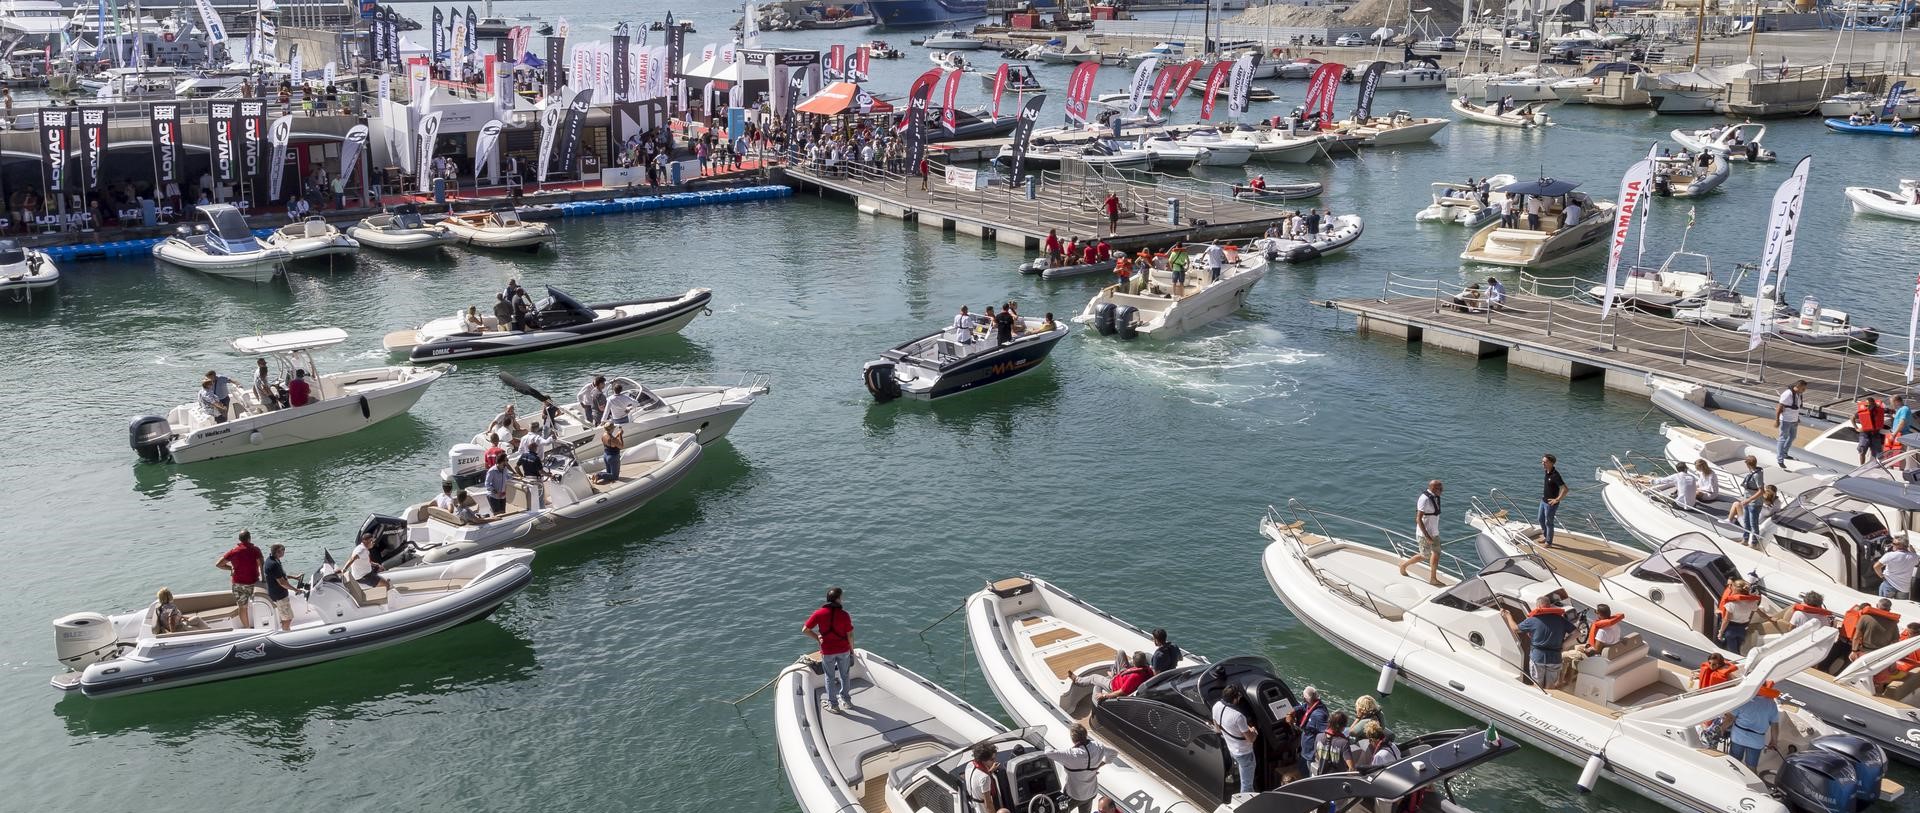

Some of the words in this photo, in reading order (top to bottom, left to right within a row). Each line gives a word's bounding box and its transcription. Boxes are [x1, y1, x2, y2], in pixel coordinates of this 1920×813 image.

[376, 21, 384, 60] EVINRUDE
[640, 53, 648, 84] YAMAHA
[1133, 66, 1148, 102] MERCURY
[1208, 68, 1222, 104] MERCURY
[1233, 65, 1243, 101] MERCURY
[1306, 69, 1327, 104] MERCURY
[1323, 73, 1335, 111] MERCURY
[1362, 69, 1376, 108] MERCURY
[48, 129, 61, 191] LOMAC
[88, 127, 98, 188] LOMAC
[158, 122, 173, 181] LOMAC
[217, 120, 230, 180] LOMAC
[245, 118, 256, 176] LOMAC
[119, 206, 173, 218] LOAC
[1615, 181, 1642, 249] YAMAHA
[457, 456, 480, 465] SELVA
[1519, 709, 1584, 743] Tempest
[1811, 790, 1837, 805] YAMAHA
